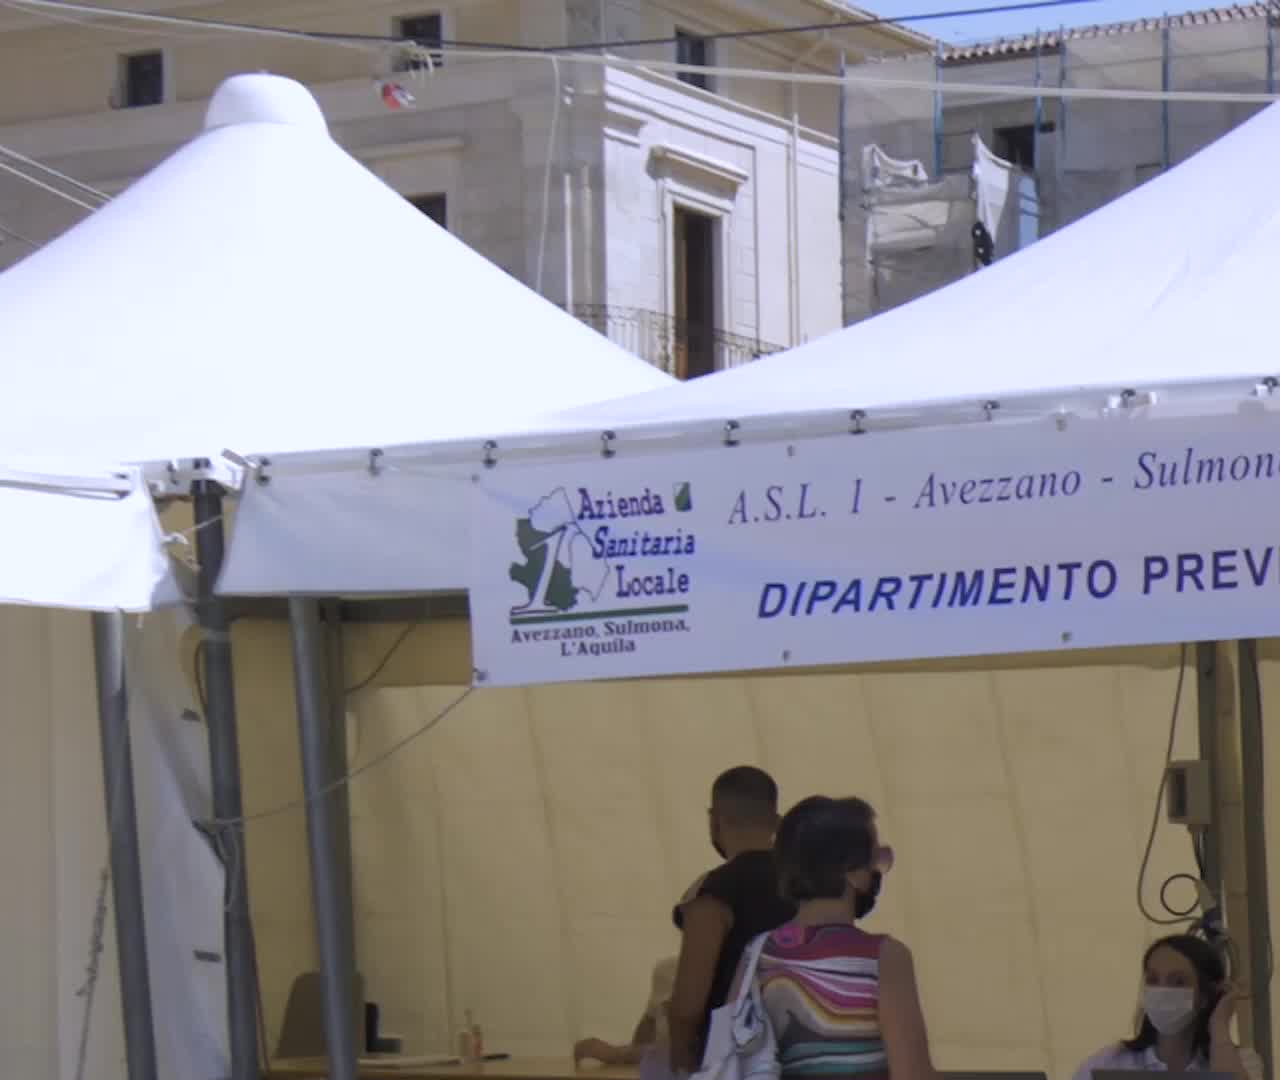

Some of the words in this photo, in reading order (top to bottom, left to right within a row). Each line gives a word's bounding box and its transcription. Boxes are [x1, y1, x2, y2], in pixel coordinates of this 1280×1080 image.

[577, 487, 666, 522] Azienda
[727, 483, 827, 525] A.S.L.
[851, 478, 862, 515] 1
[914, 471, 1081, 509] Avezzano
[591, 525, 695, 560] Sanitaria
[615, 564, 690, 598] Locale
[758, 559, 1118, 619] DIPARTIMENTO
